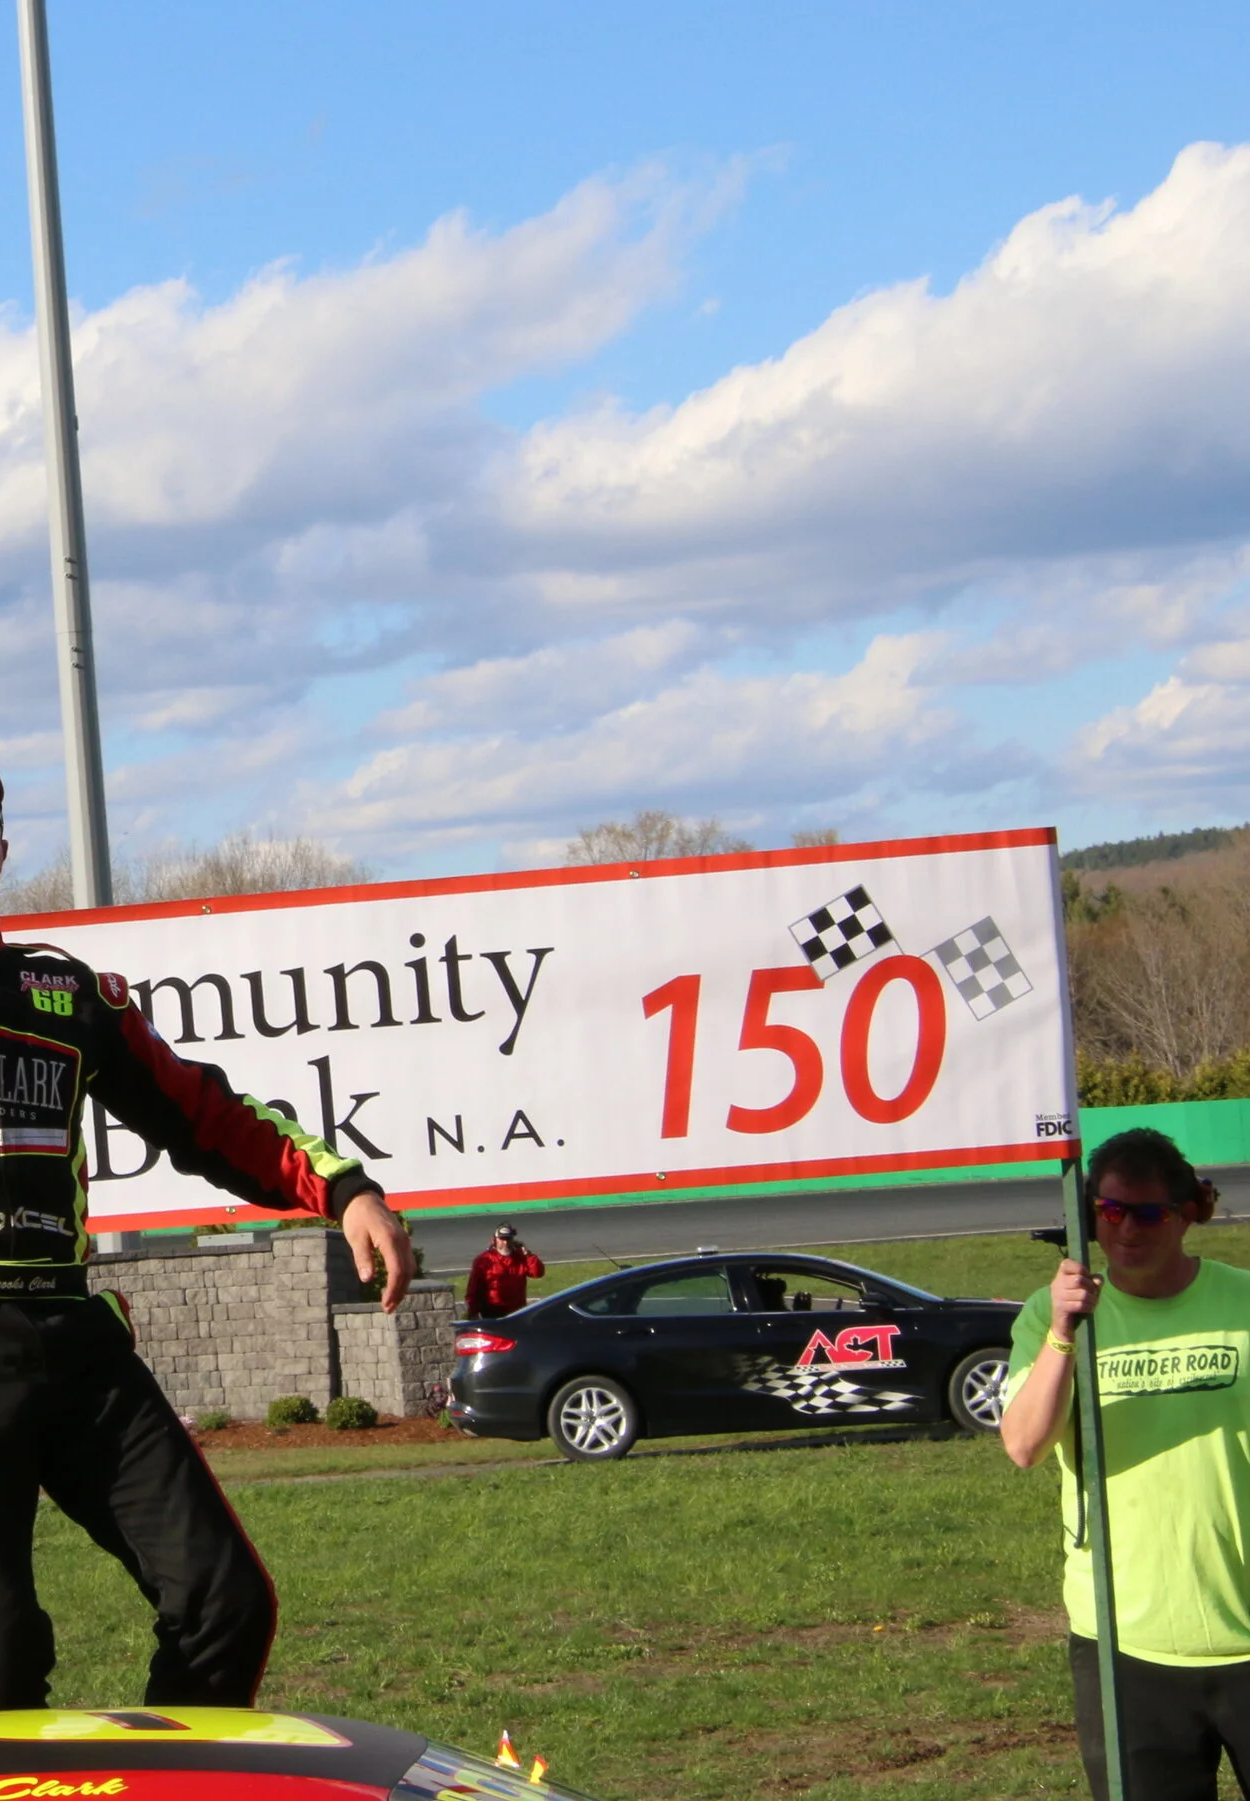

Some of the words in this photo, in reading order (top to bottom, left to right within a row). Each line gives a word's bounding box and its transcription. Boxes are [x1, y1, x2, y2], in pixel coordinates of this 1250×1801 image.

[19, 970, 78, 987] CLARK
[31, 987, 73, 1016] 68
[130, 932, 555, 1056] munity
[642, 954, 947, 1139] 150
[1036, 1120, 1073, 1137] FDIC
[28, 1276, 57, 1291] Clark
[796, 1324, 902, 1367] ACT
[1098, 1355, 1181, 1379] THUNDER
[1186, 1352, 1232, 1372] ROAD
